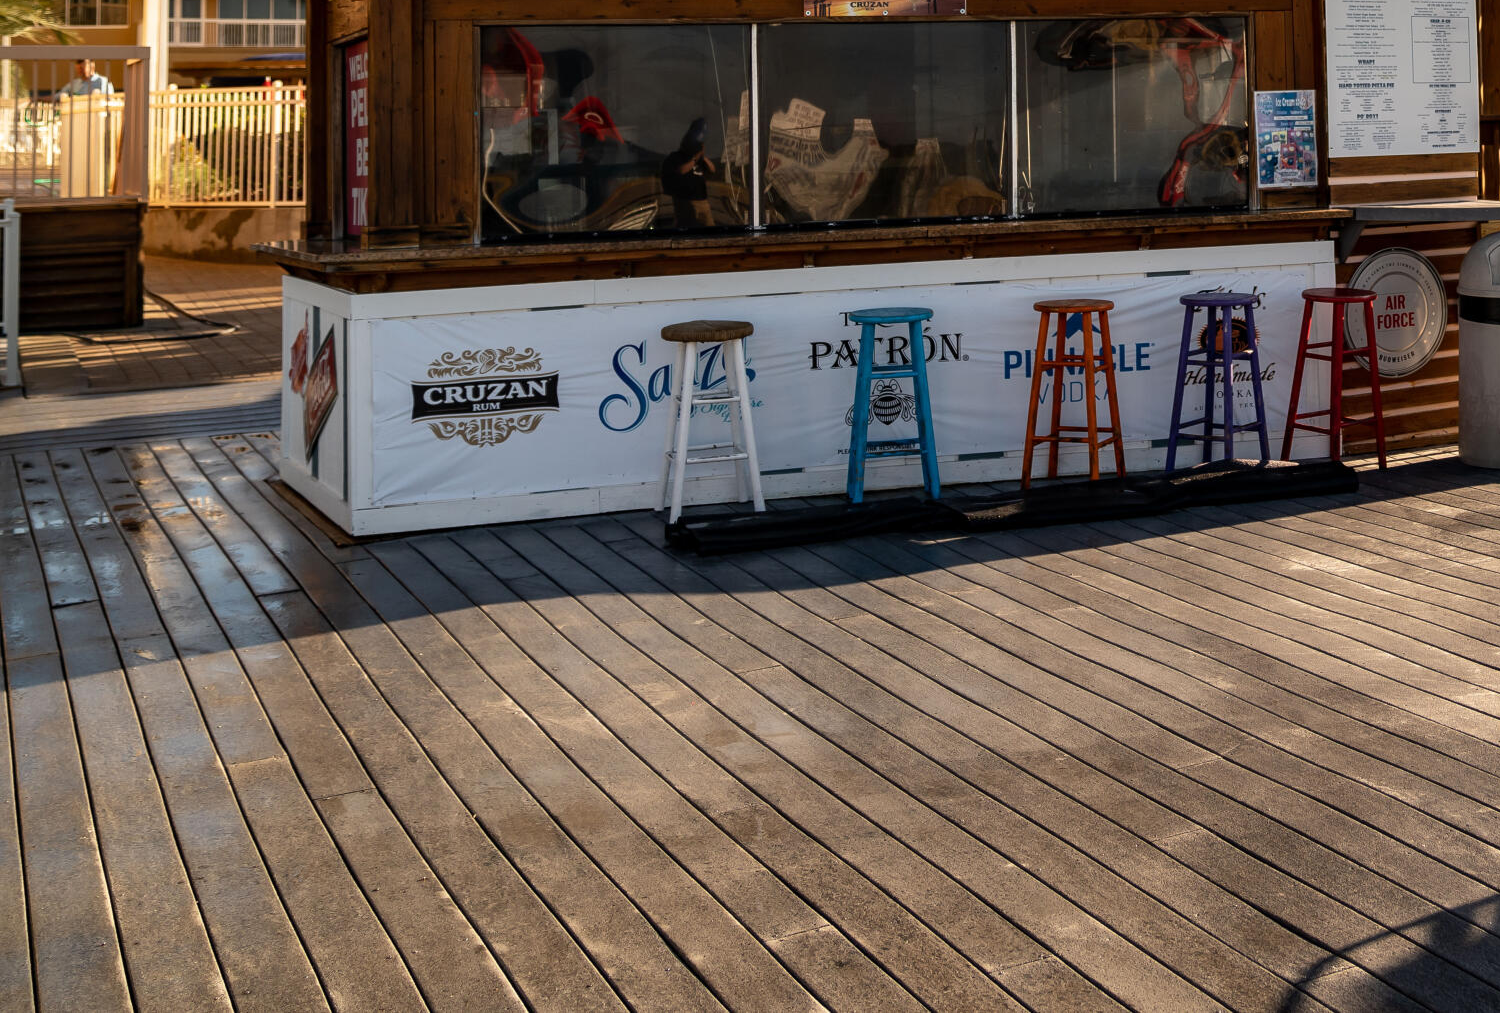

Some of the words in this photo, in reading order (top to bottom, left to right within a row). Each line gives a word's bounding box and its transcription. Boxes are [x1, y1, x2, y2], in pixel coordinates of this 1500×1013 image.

[1385, 294, 1406, 311] AIR
[1376, 312, 1416, 330] FORCE
[422, 380, 548, 405] CRUZAN
[472, 402, 501, 412] RUM
